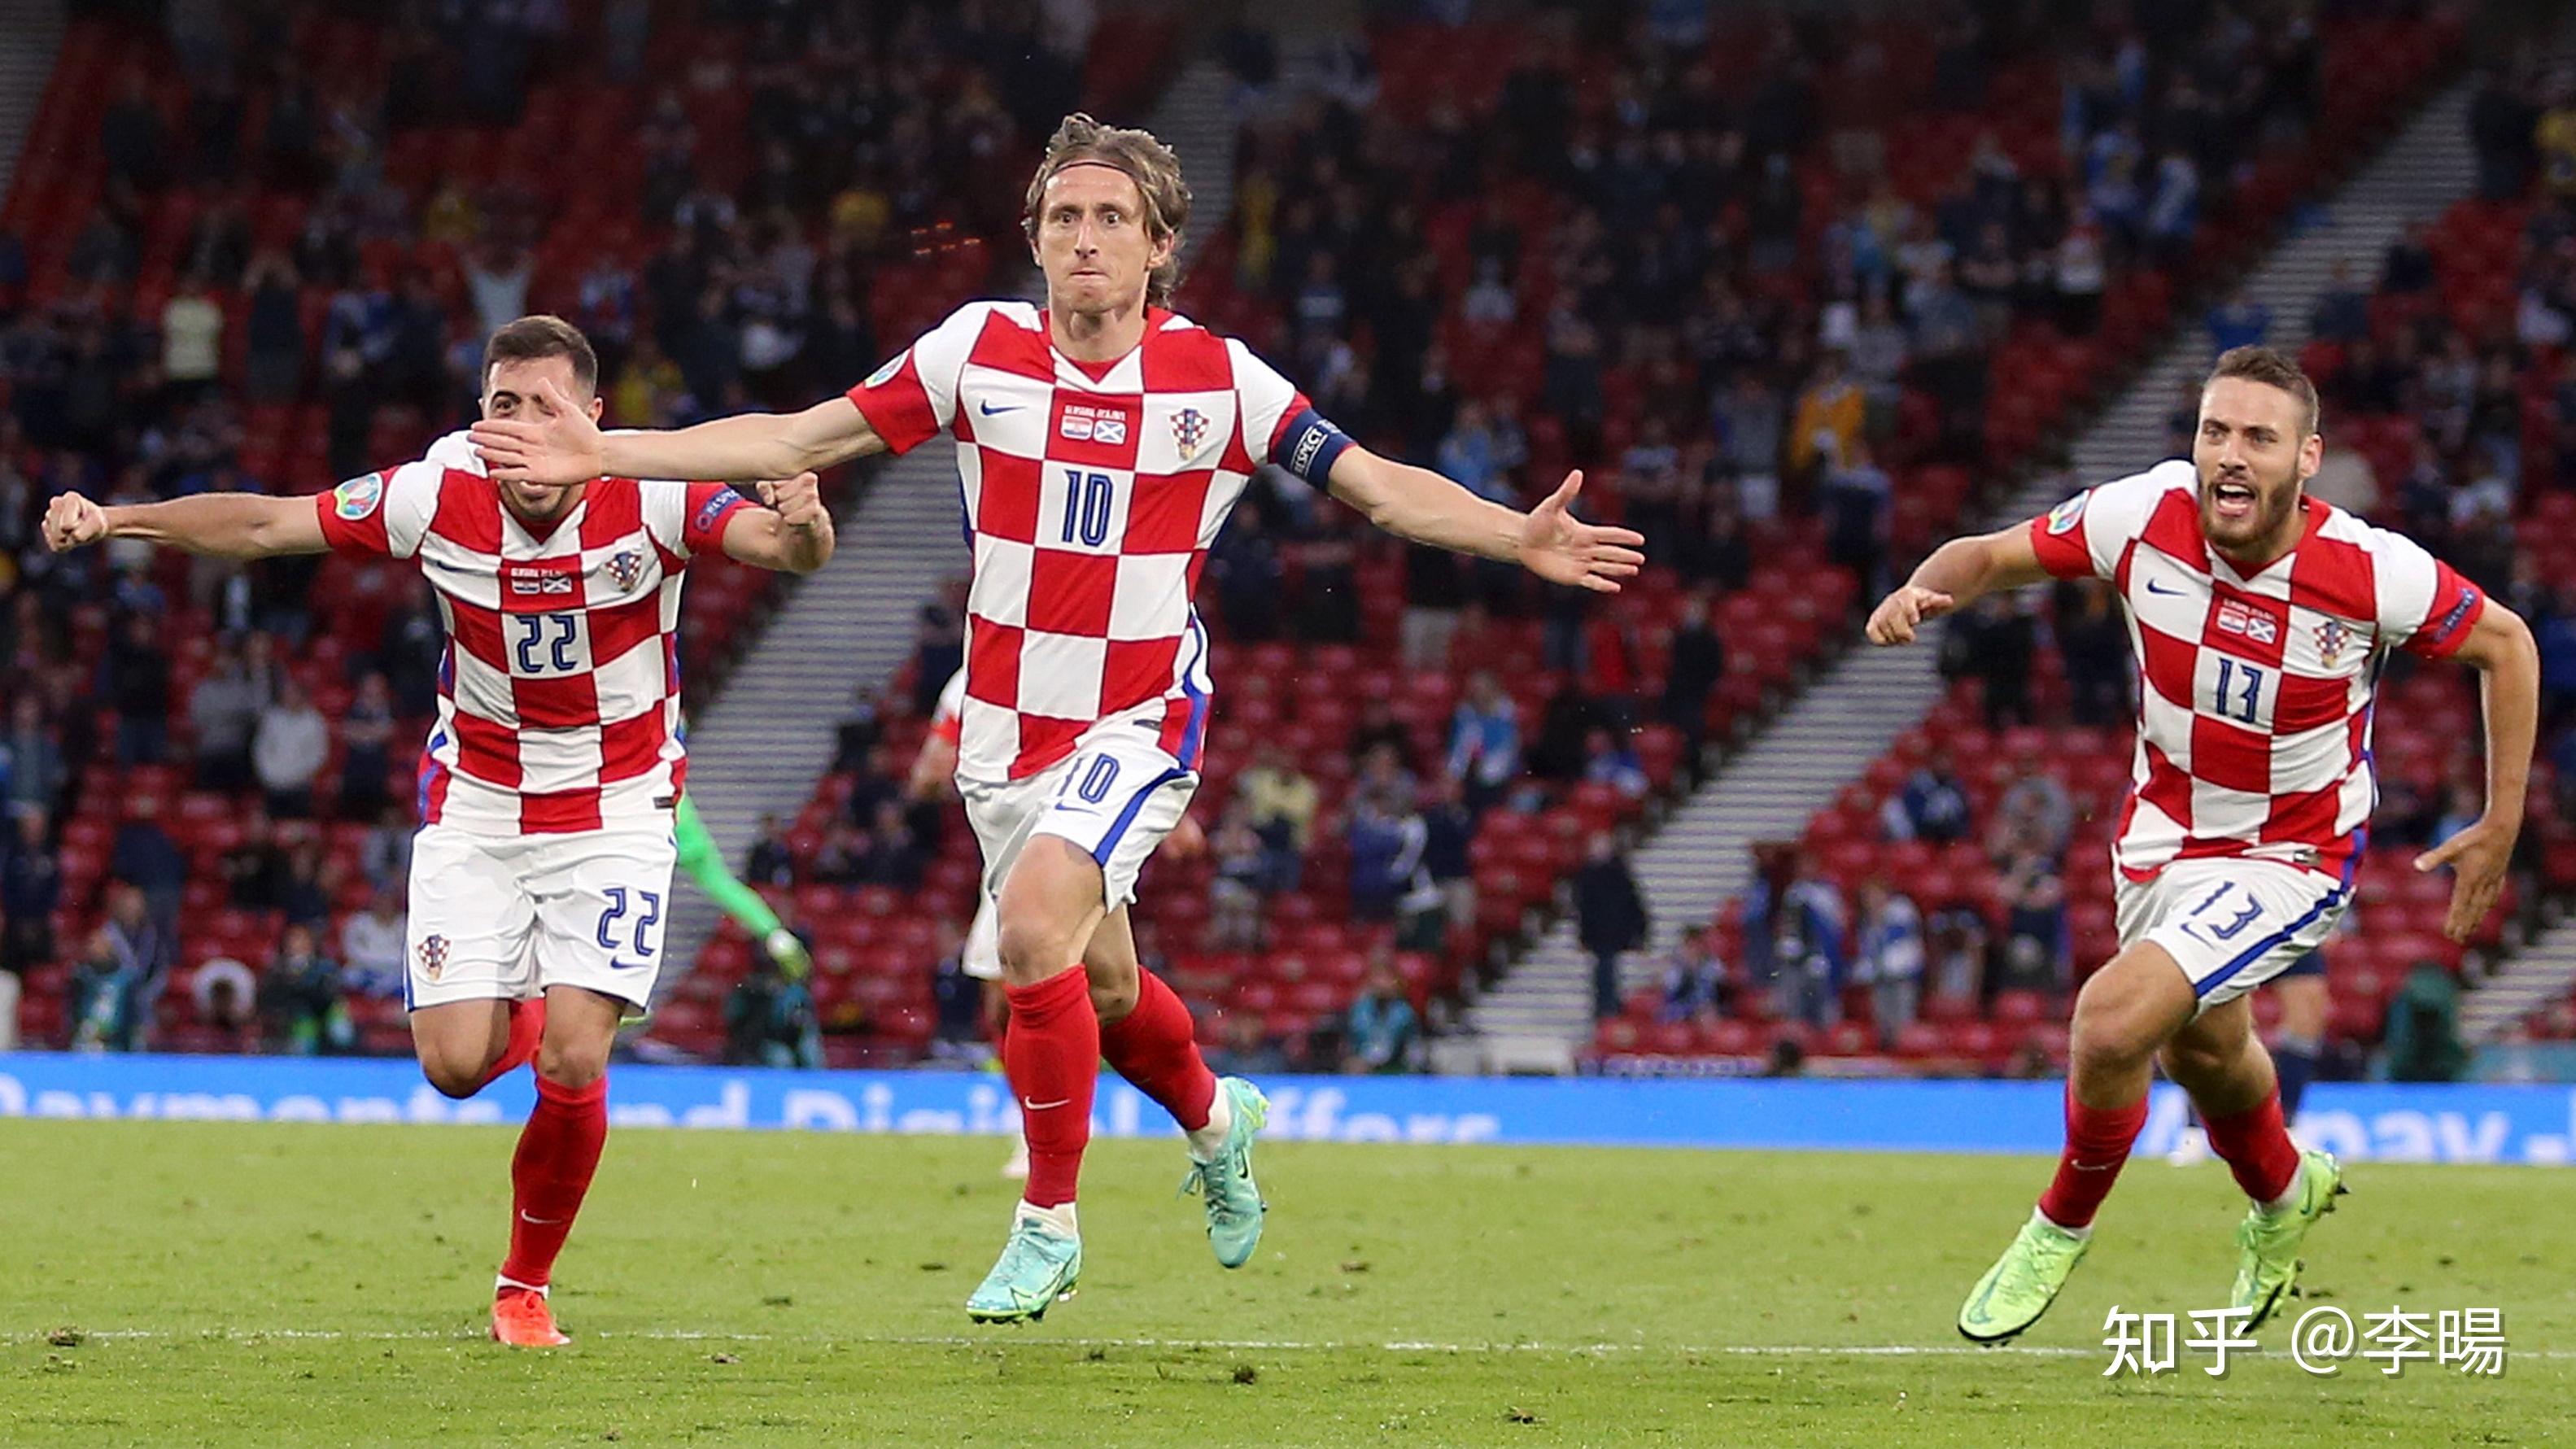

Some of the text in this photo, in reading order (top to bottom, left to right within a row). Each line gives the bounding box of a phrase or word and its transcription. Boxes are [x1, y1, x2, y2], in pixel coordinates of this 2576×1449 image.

[1061, 469, 1114, 547] 10
[515, 615, 577, 674] 22
[2216, 657, 2264, 723] 13
[1057, 753, 1121, 804] 10
[596, 888, 660, 956] 22
[2190, 881, 2264, 940] 13
